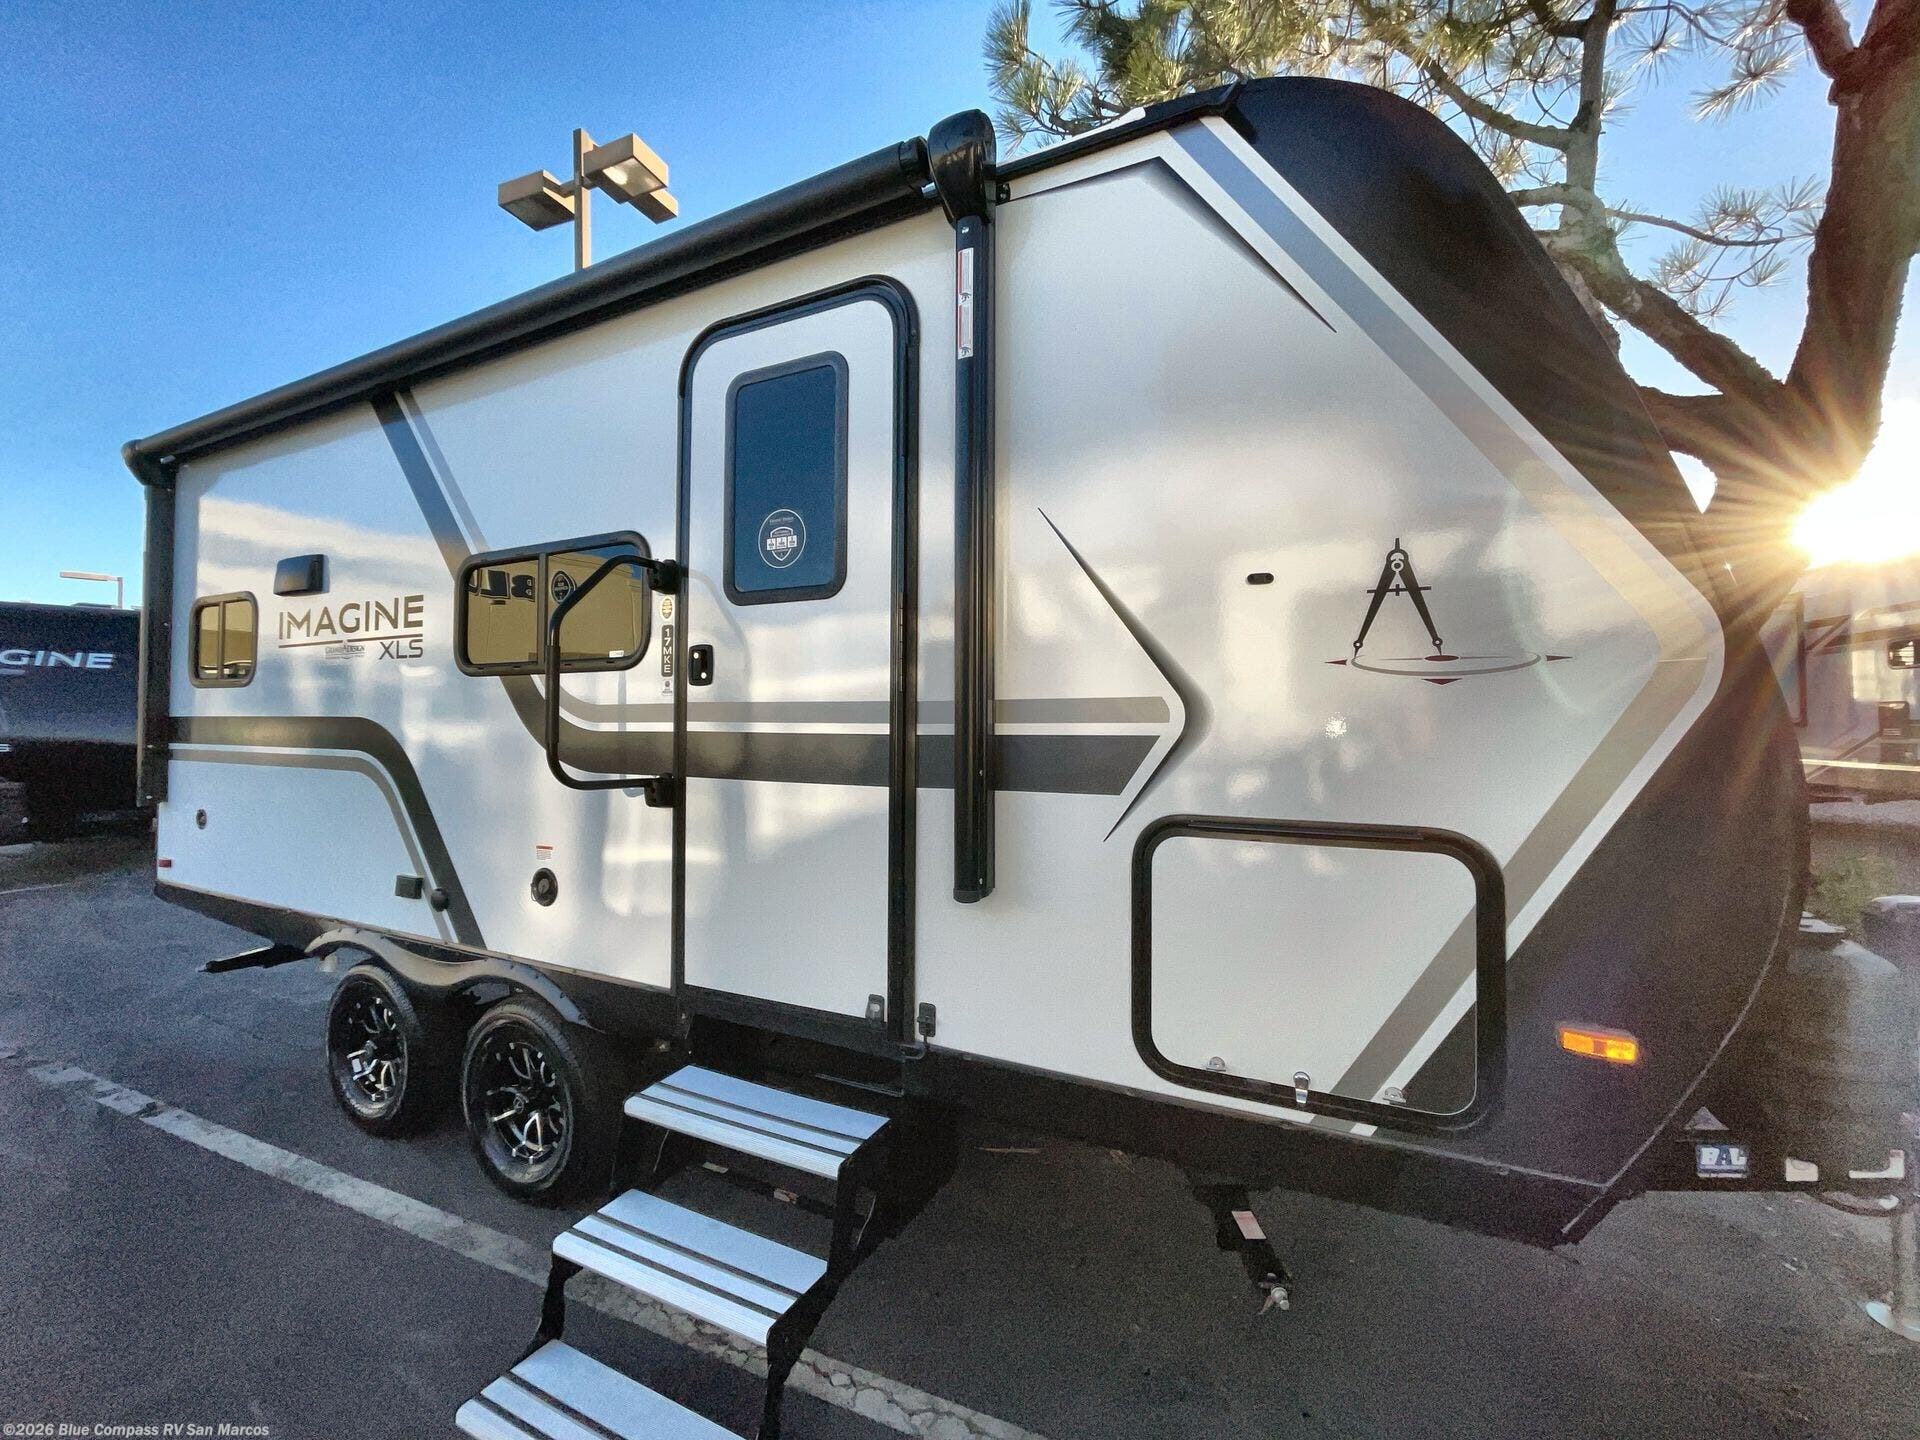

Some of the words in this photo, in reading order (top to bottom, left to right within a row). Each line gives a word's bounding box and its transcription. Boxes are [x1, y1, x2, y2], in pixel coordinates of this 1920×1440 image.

[278, 594, 424, 640] IMAGINE
[379, 638, 424, 660] XLS
[663, 628, 673, 673] 17MKE
